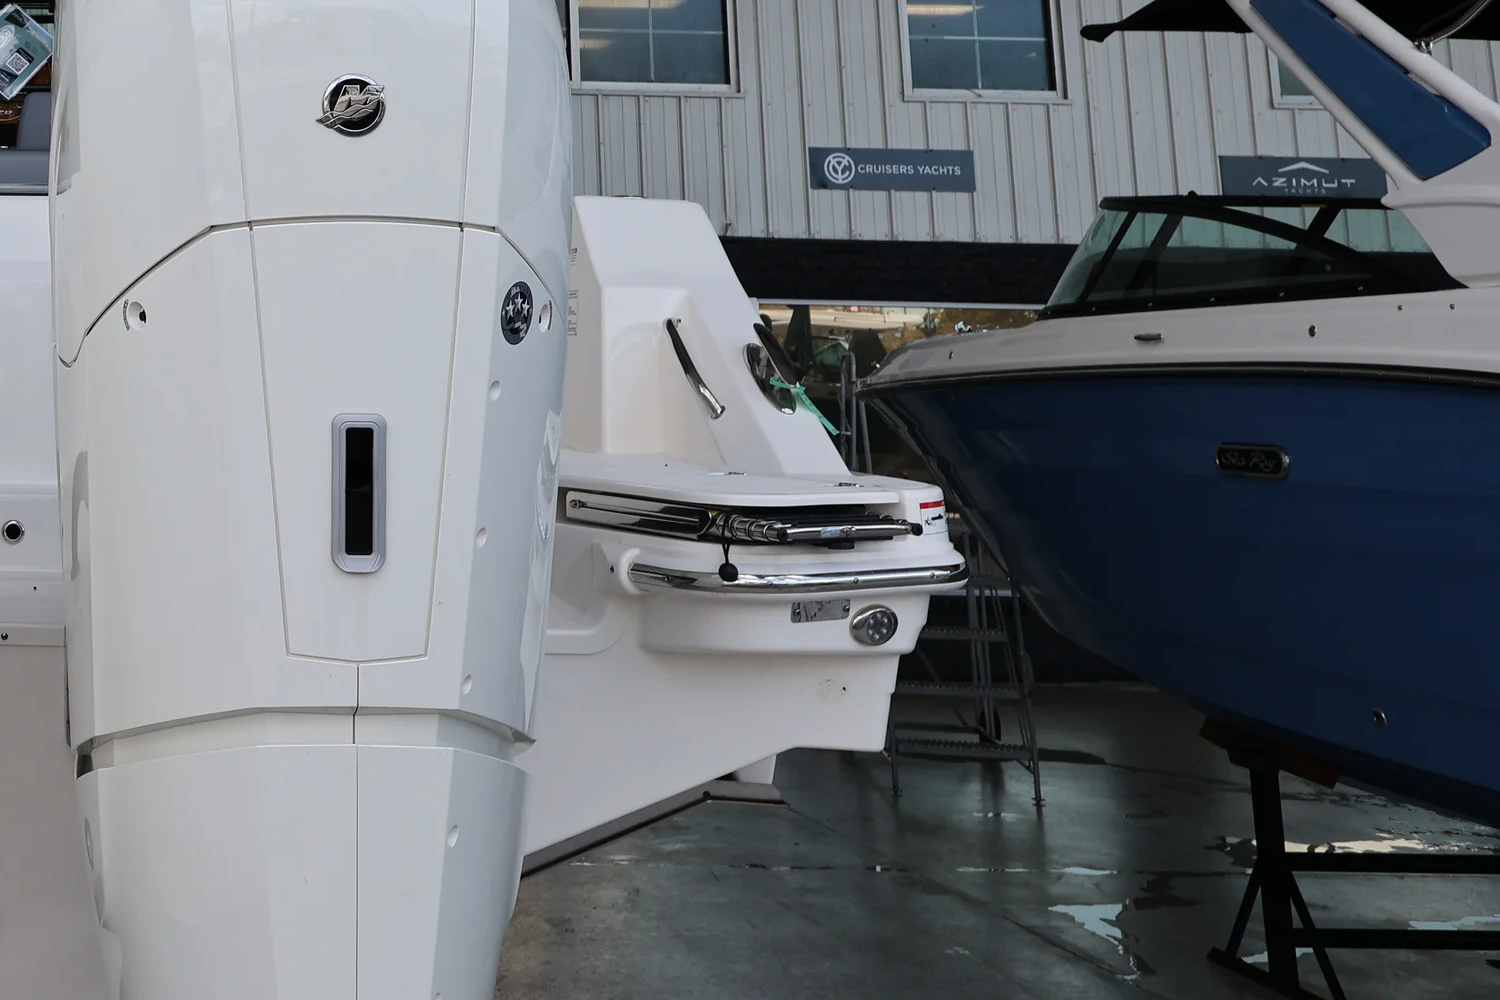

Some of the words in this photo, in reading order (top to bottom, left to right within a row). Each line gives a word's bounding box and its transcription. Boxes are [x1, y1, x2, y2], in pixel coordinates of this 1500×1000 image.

[858, 164, 914, 175] CRUISERS
[917, 165, 961, 176] YACHTS
[1252, 177, 1356, 188] AZIMUT
